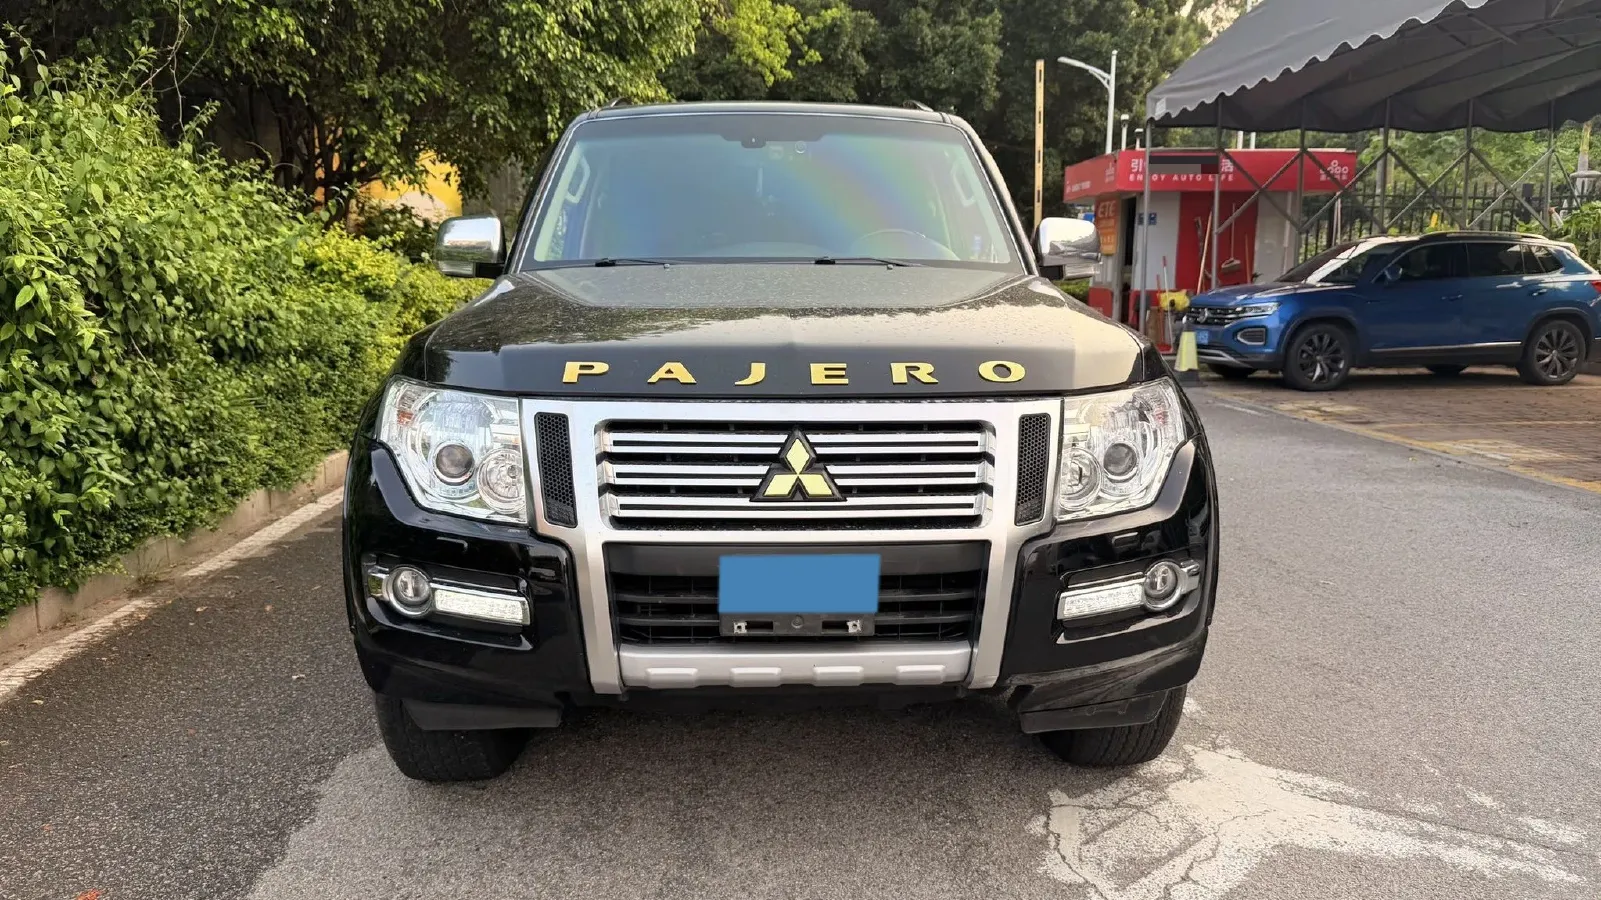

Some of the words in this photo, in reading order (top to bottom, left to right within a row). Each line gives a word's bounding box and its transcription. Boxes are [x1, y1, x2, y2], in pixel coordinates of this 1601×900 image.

[1129, 173, 1165, 182] ENOY
[1172, 173, 1202, 182] AUTO
[1208, 173, 1233, 182] LFE
[562, 360, 1026, 385] PAJERO
